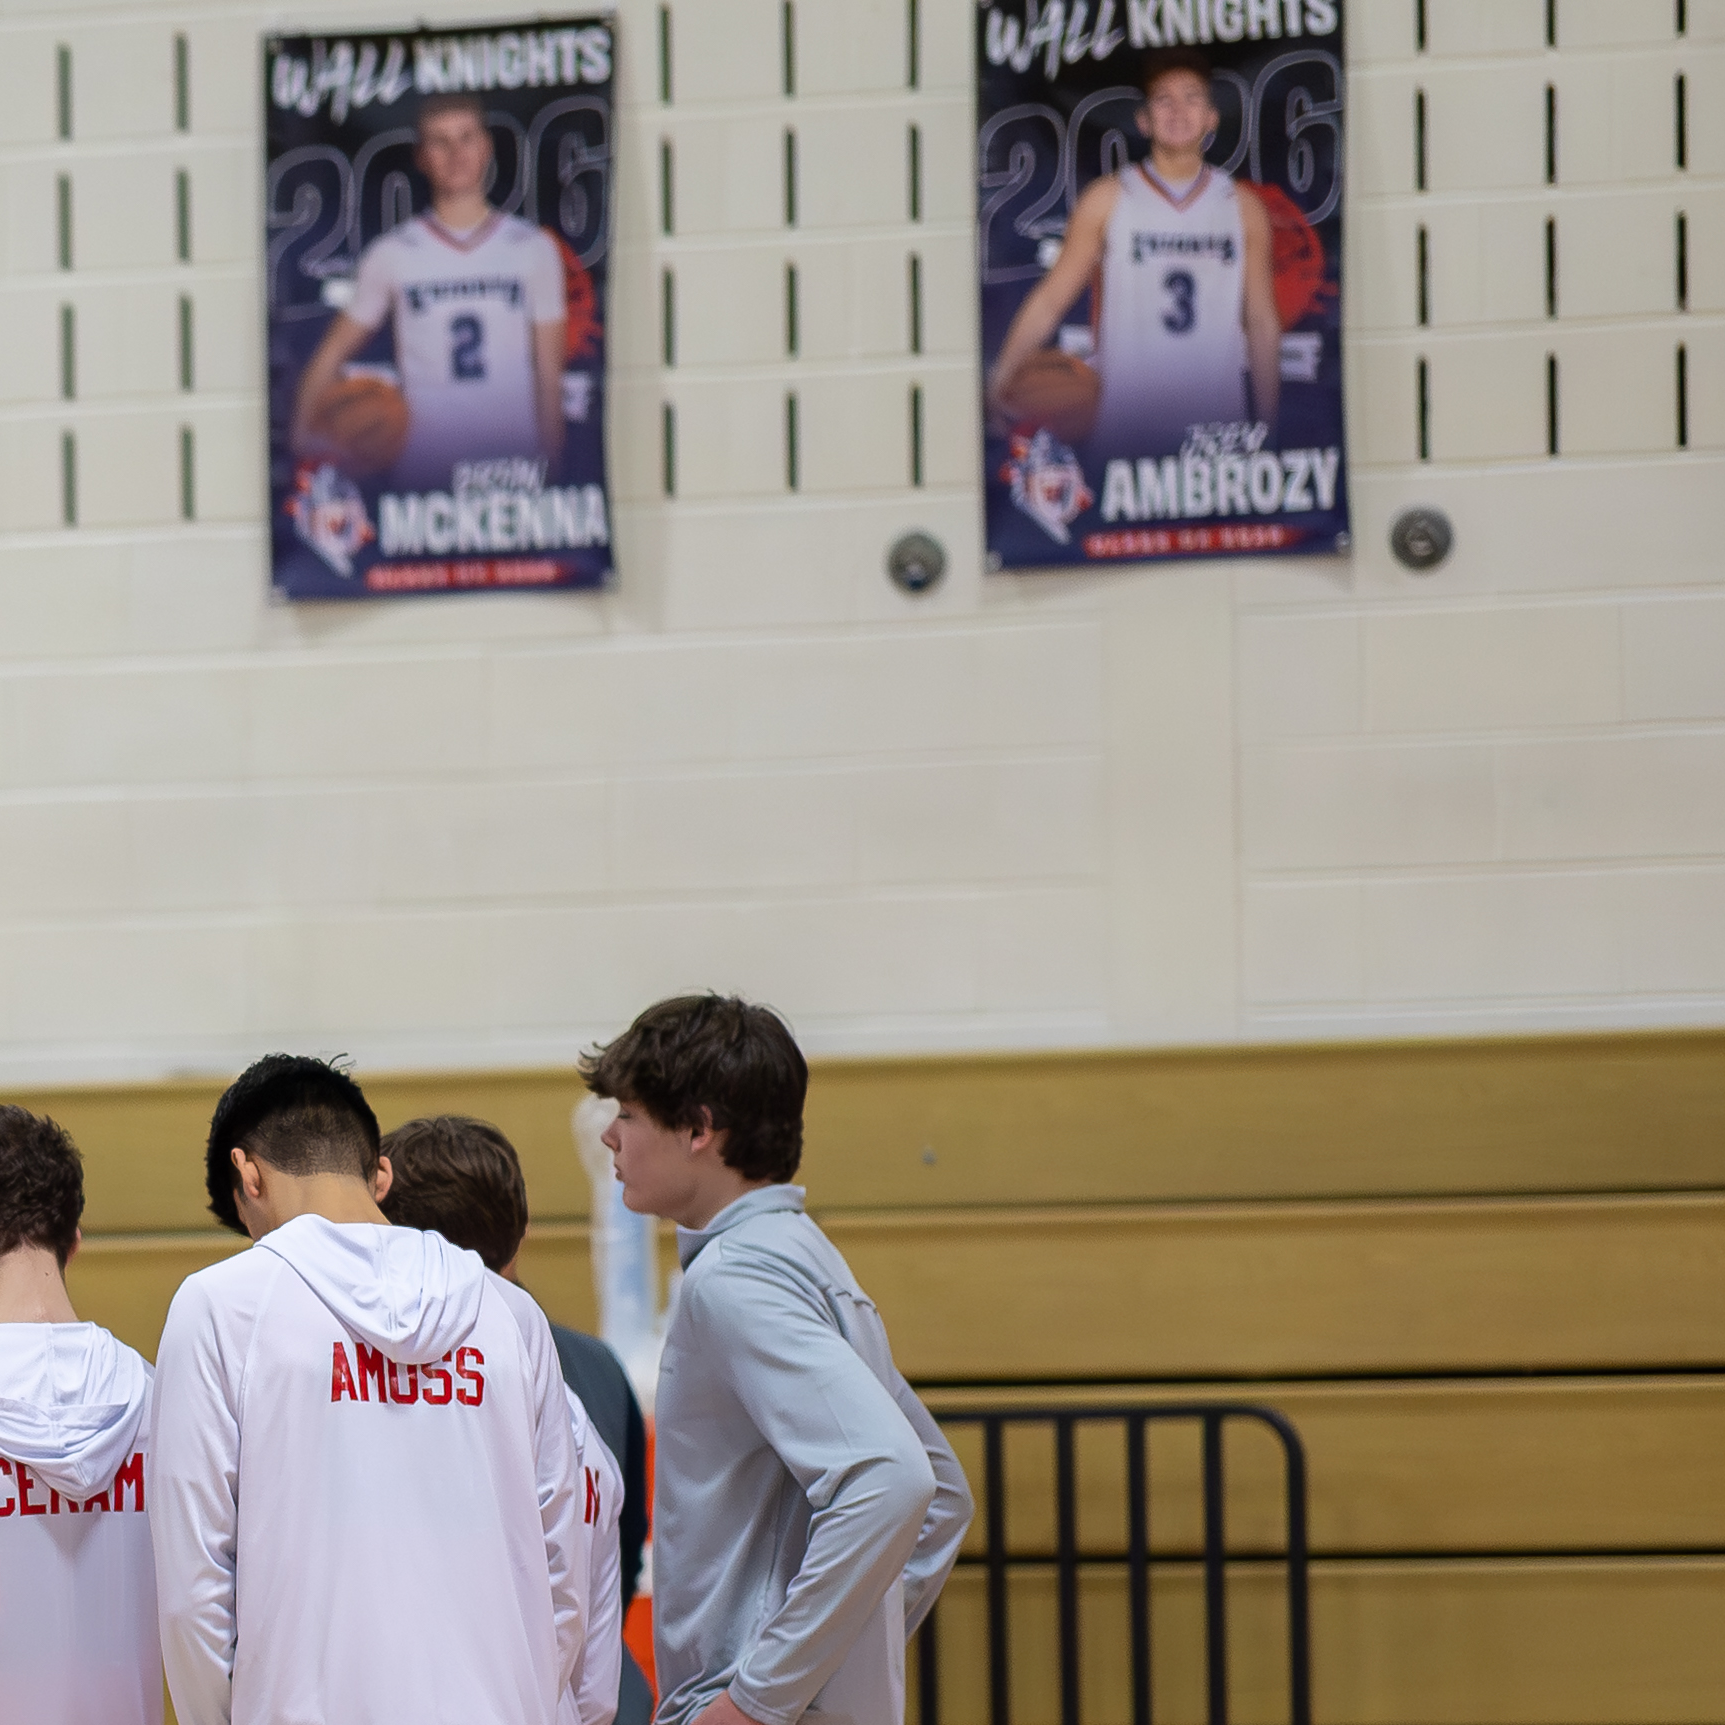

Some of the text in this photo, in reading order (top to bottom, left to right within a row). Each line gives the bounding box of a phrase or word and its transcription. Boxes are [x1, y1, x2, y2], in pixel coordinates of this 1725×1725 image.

[1128, 0, 1338, 48] KNIGHTS
[413, 26, 611, 95] KNIGHTS
[1161, 268, 1196, 334] 3
[450, 314, 486, 380] 2
[1101, 447, 1339, 523] AMBROZY
[379, 484, 608, 557] MCKENNA
[331, 1341, 485, 1407] AMOSS
